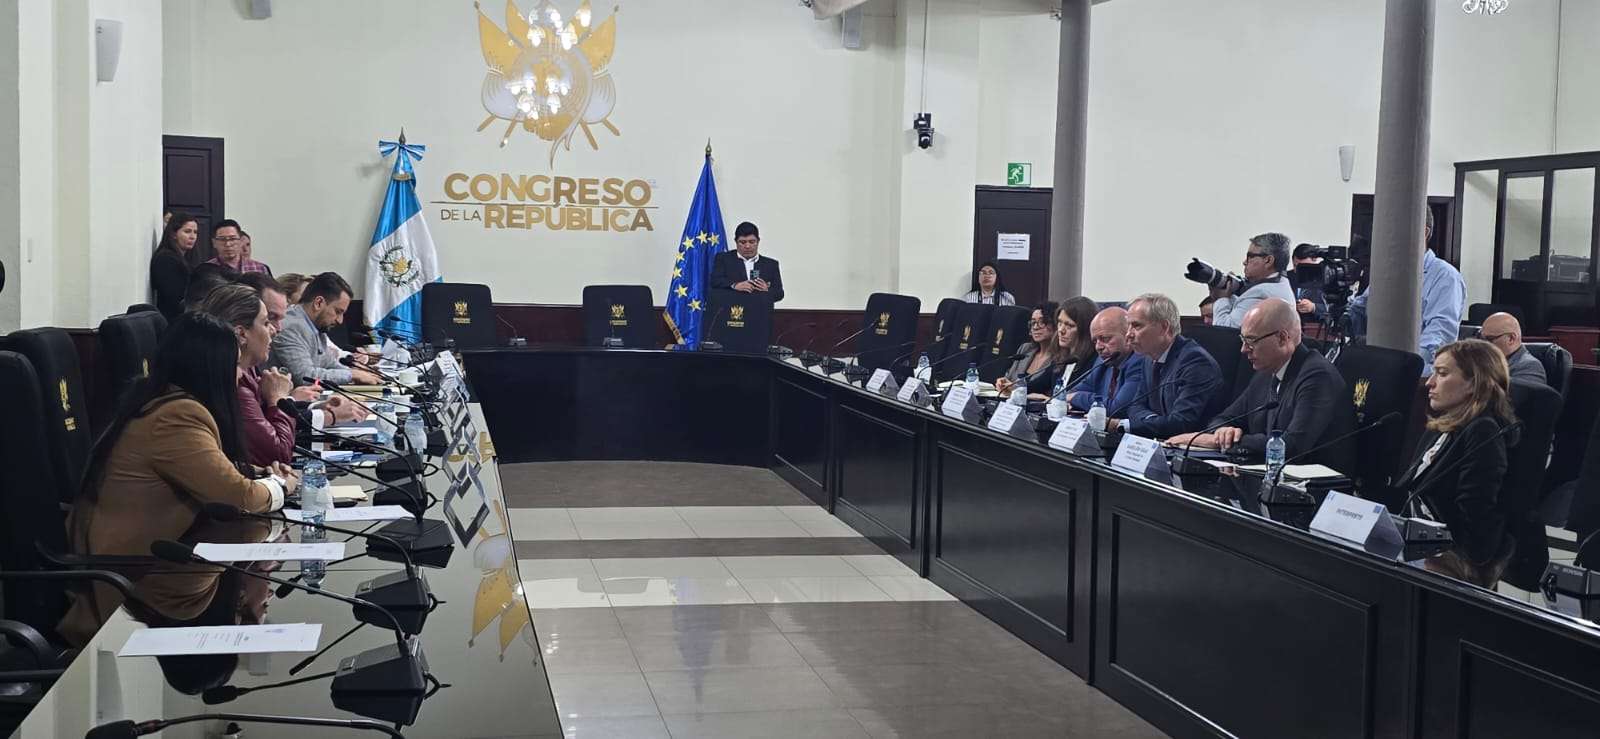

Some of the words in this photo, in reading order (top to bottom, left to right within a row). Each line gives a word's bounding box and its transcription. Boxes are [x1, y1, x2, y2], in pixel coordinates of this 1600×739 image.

[444, 172, 652, 206] CONGRESO
[440, 208, 459, 221] DE
[463, 209, 482, 222] LA
[484, 203, 654, 232] REPÚBLICA
